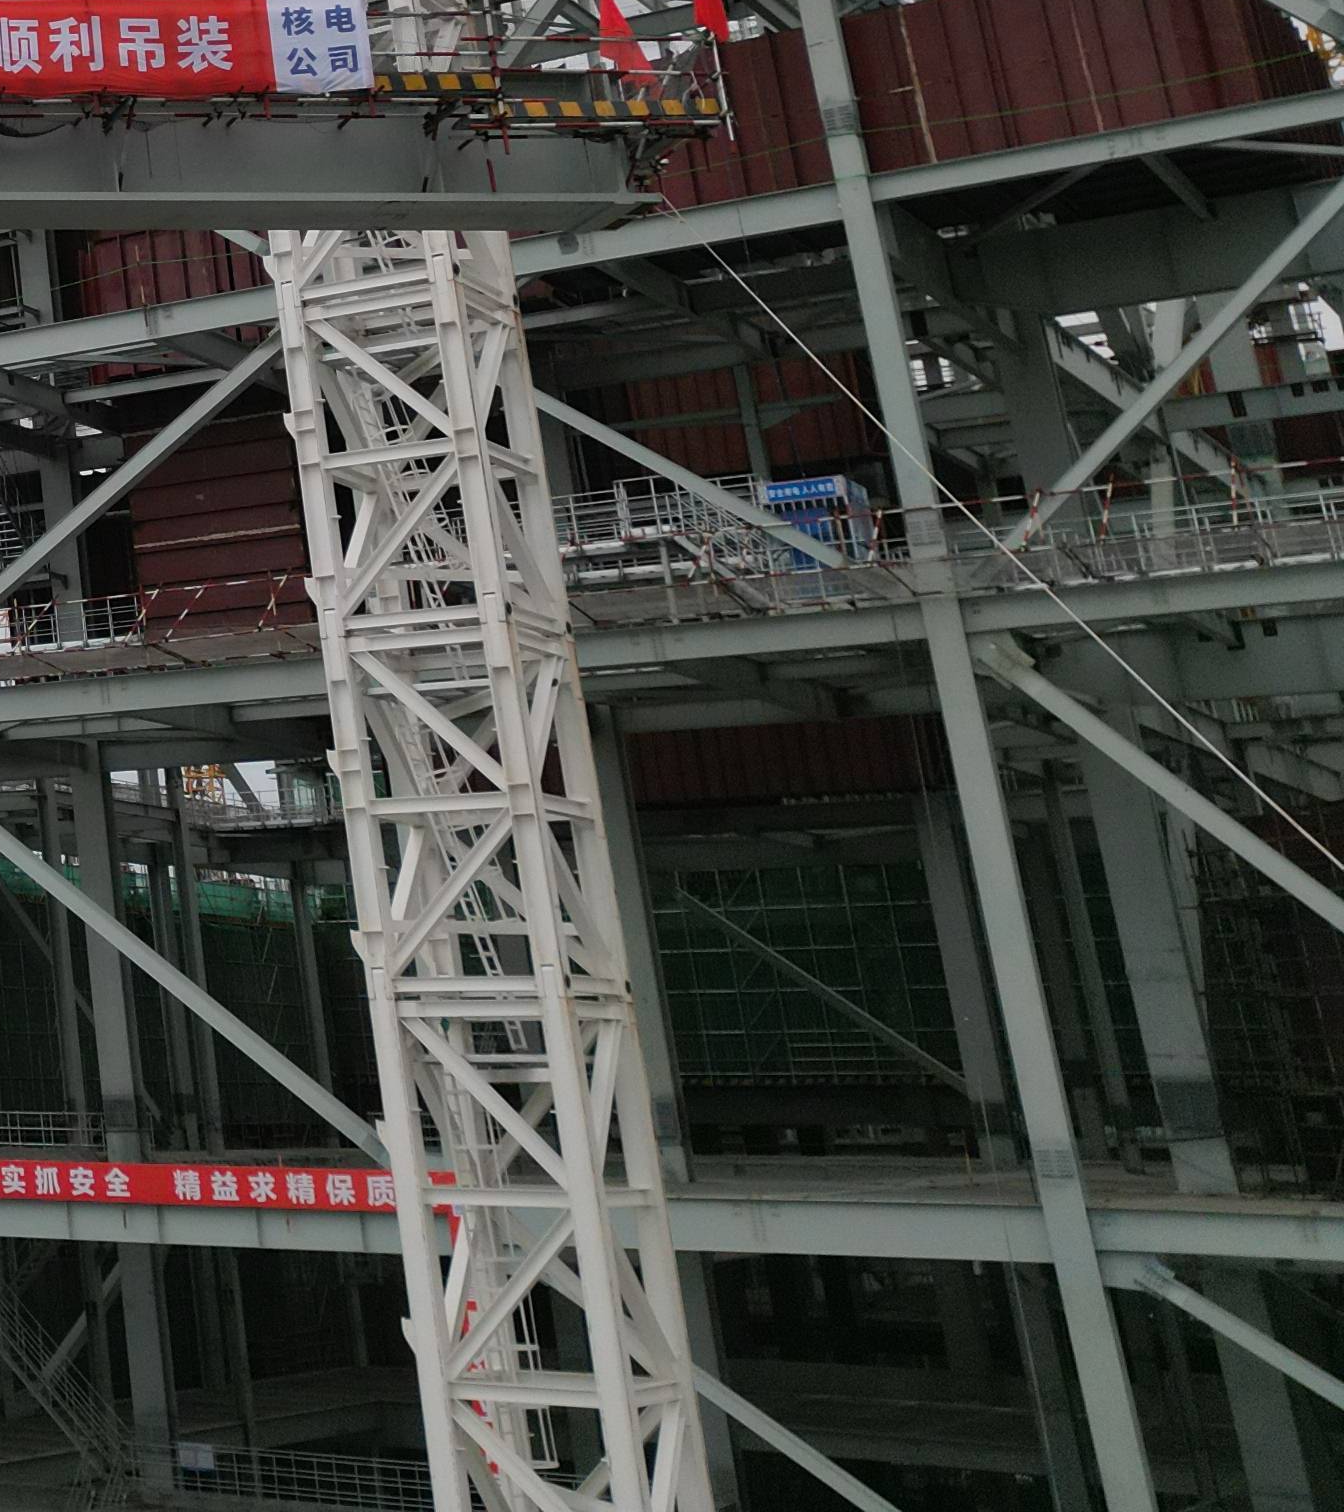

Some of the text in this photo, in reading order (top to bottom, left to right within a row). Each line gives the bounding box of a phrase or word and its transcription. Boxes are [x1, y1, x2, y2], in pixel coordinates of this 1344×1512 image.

[281, 4, 357, 37] 核电
[286, 44, 359, 77] 公司
[174, 1169, 432, 1208] 精益求精保质
